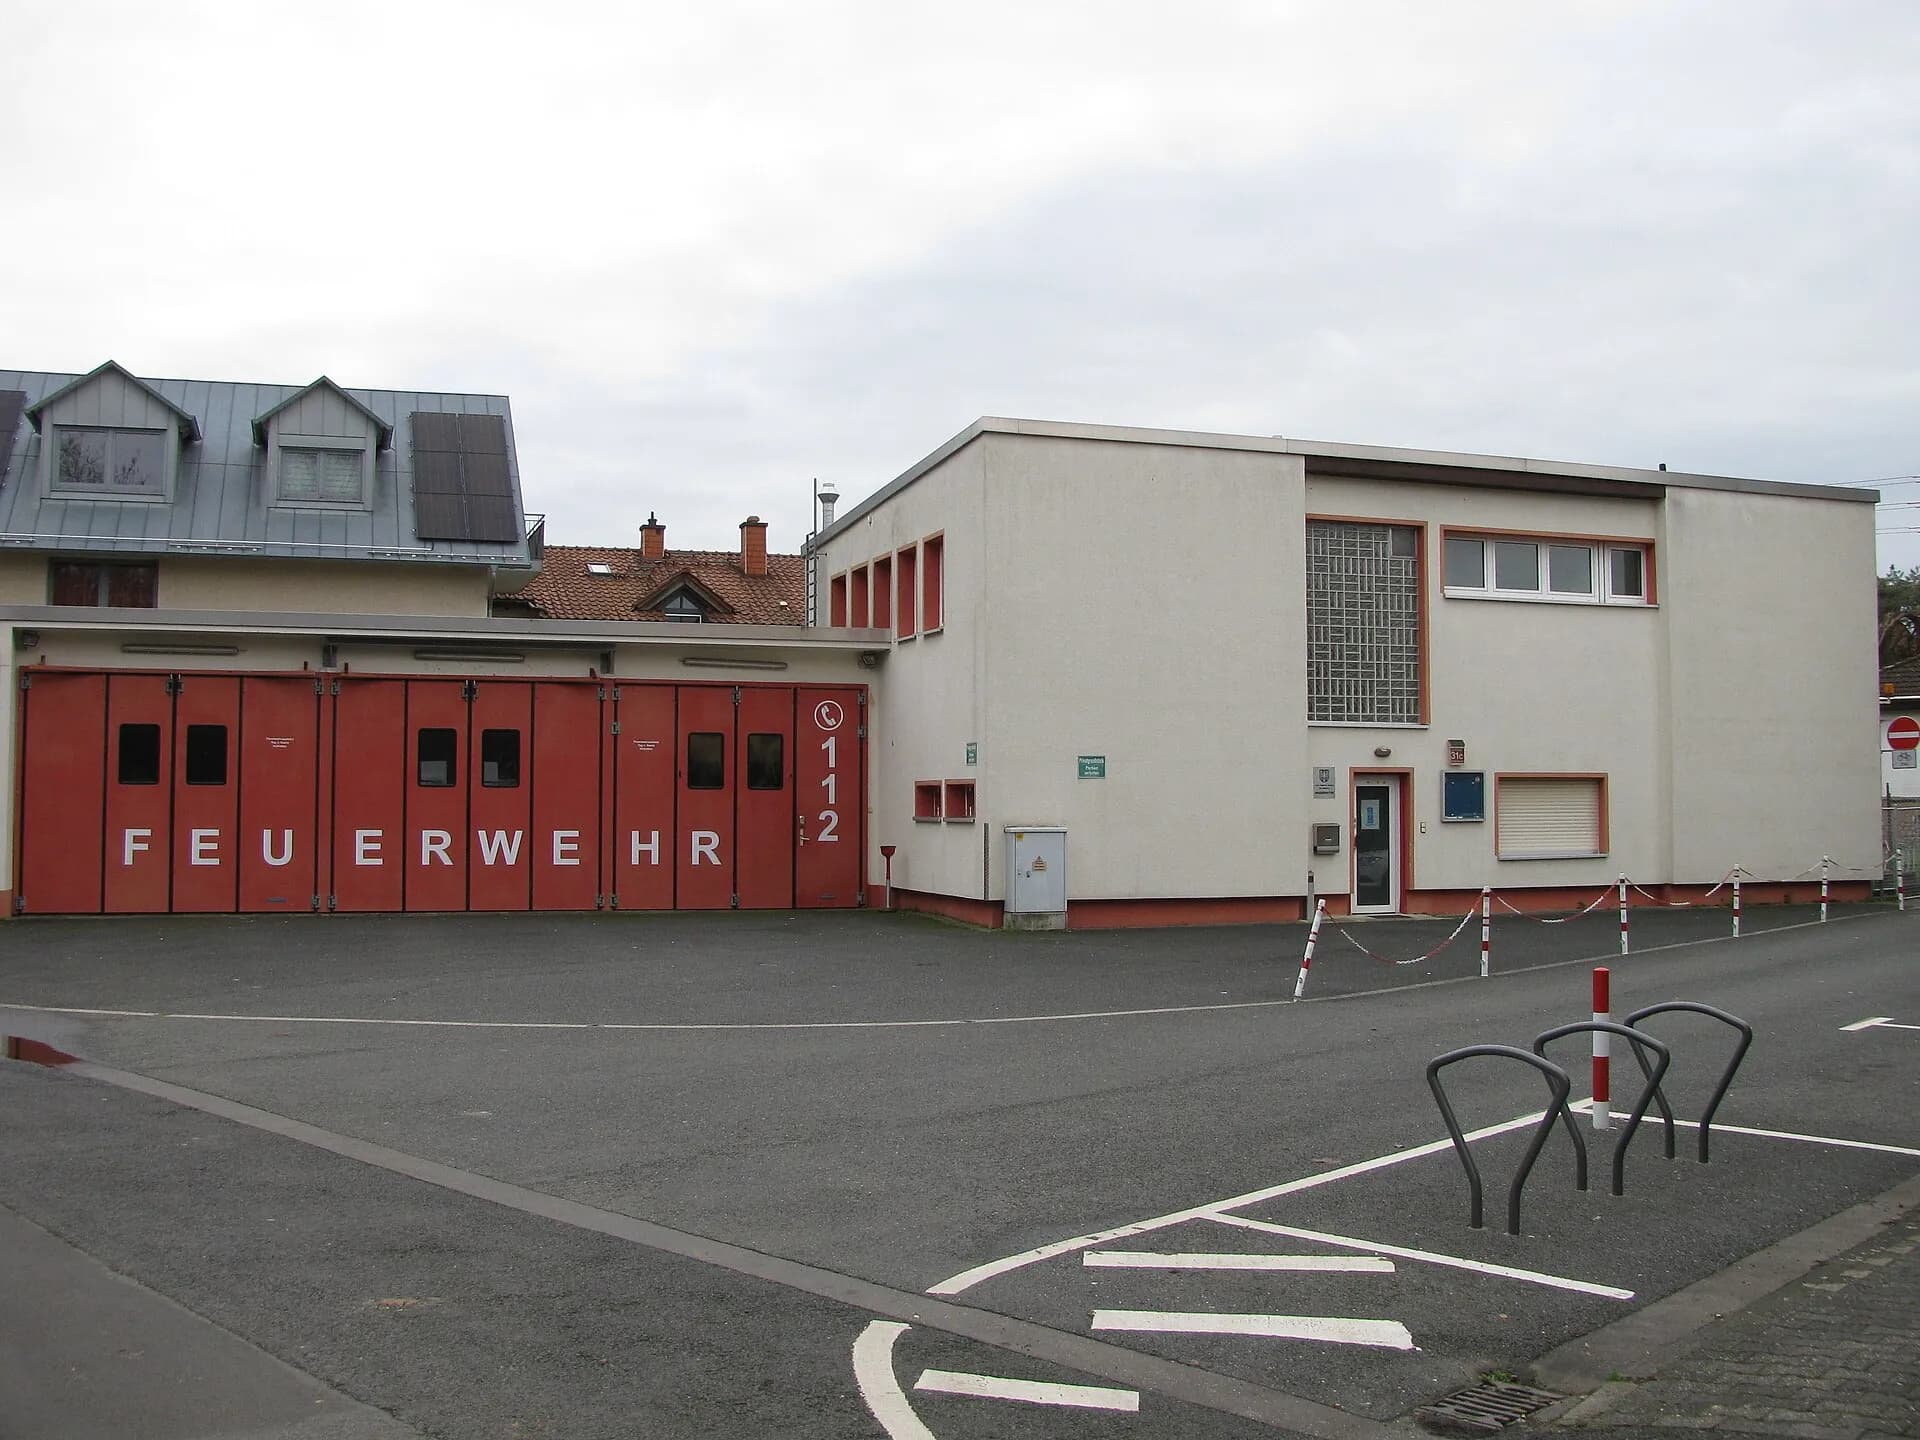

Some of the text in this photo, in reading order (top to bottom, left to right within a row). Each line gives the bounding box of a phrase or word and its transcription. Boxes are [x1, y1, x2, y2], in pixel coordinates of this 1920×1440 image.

[1450, 751, 1464, 760] 31c
[817, 736, 839, 842] 112
[124, 828, 722, 867] FEUERWEHR
